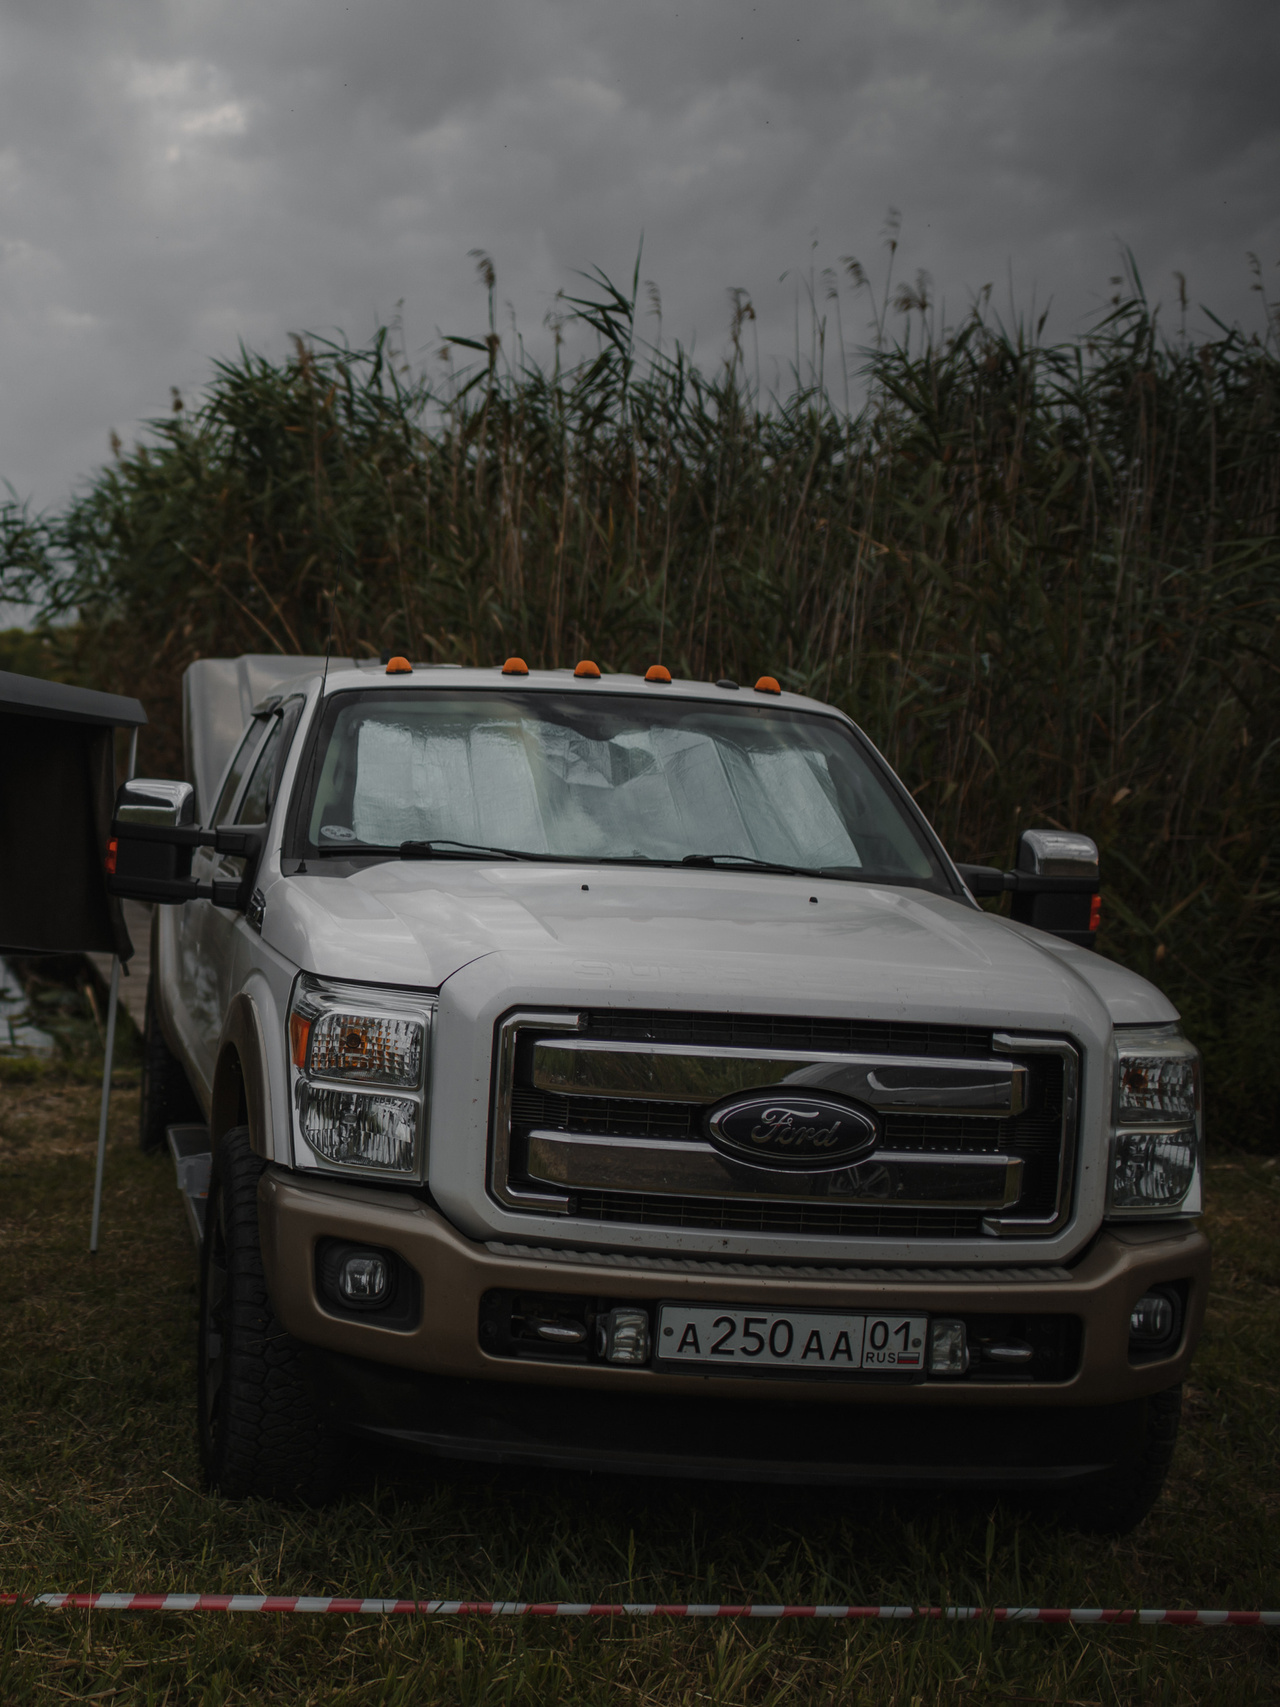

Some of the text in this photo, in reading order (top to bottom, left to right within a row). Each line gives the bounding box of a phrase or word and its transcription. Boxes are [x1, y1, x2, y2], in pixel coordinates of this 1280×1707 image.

[751, 1108, 841, 1147] Ford
[869, 1320, 912, 1352] 01
[865, 1352, 897, 1364] RUS
